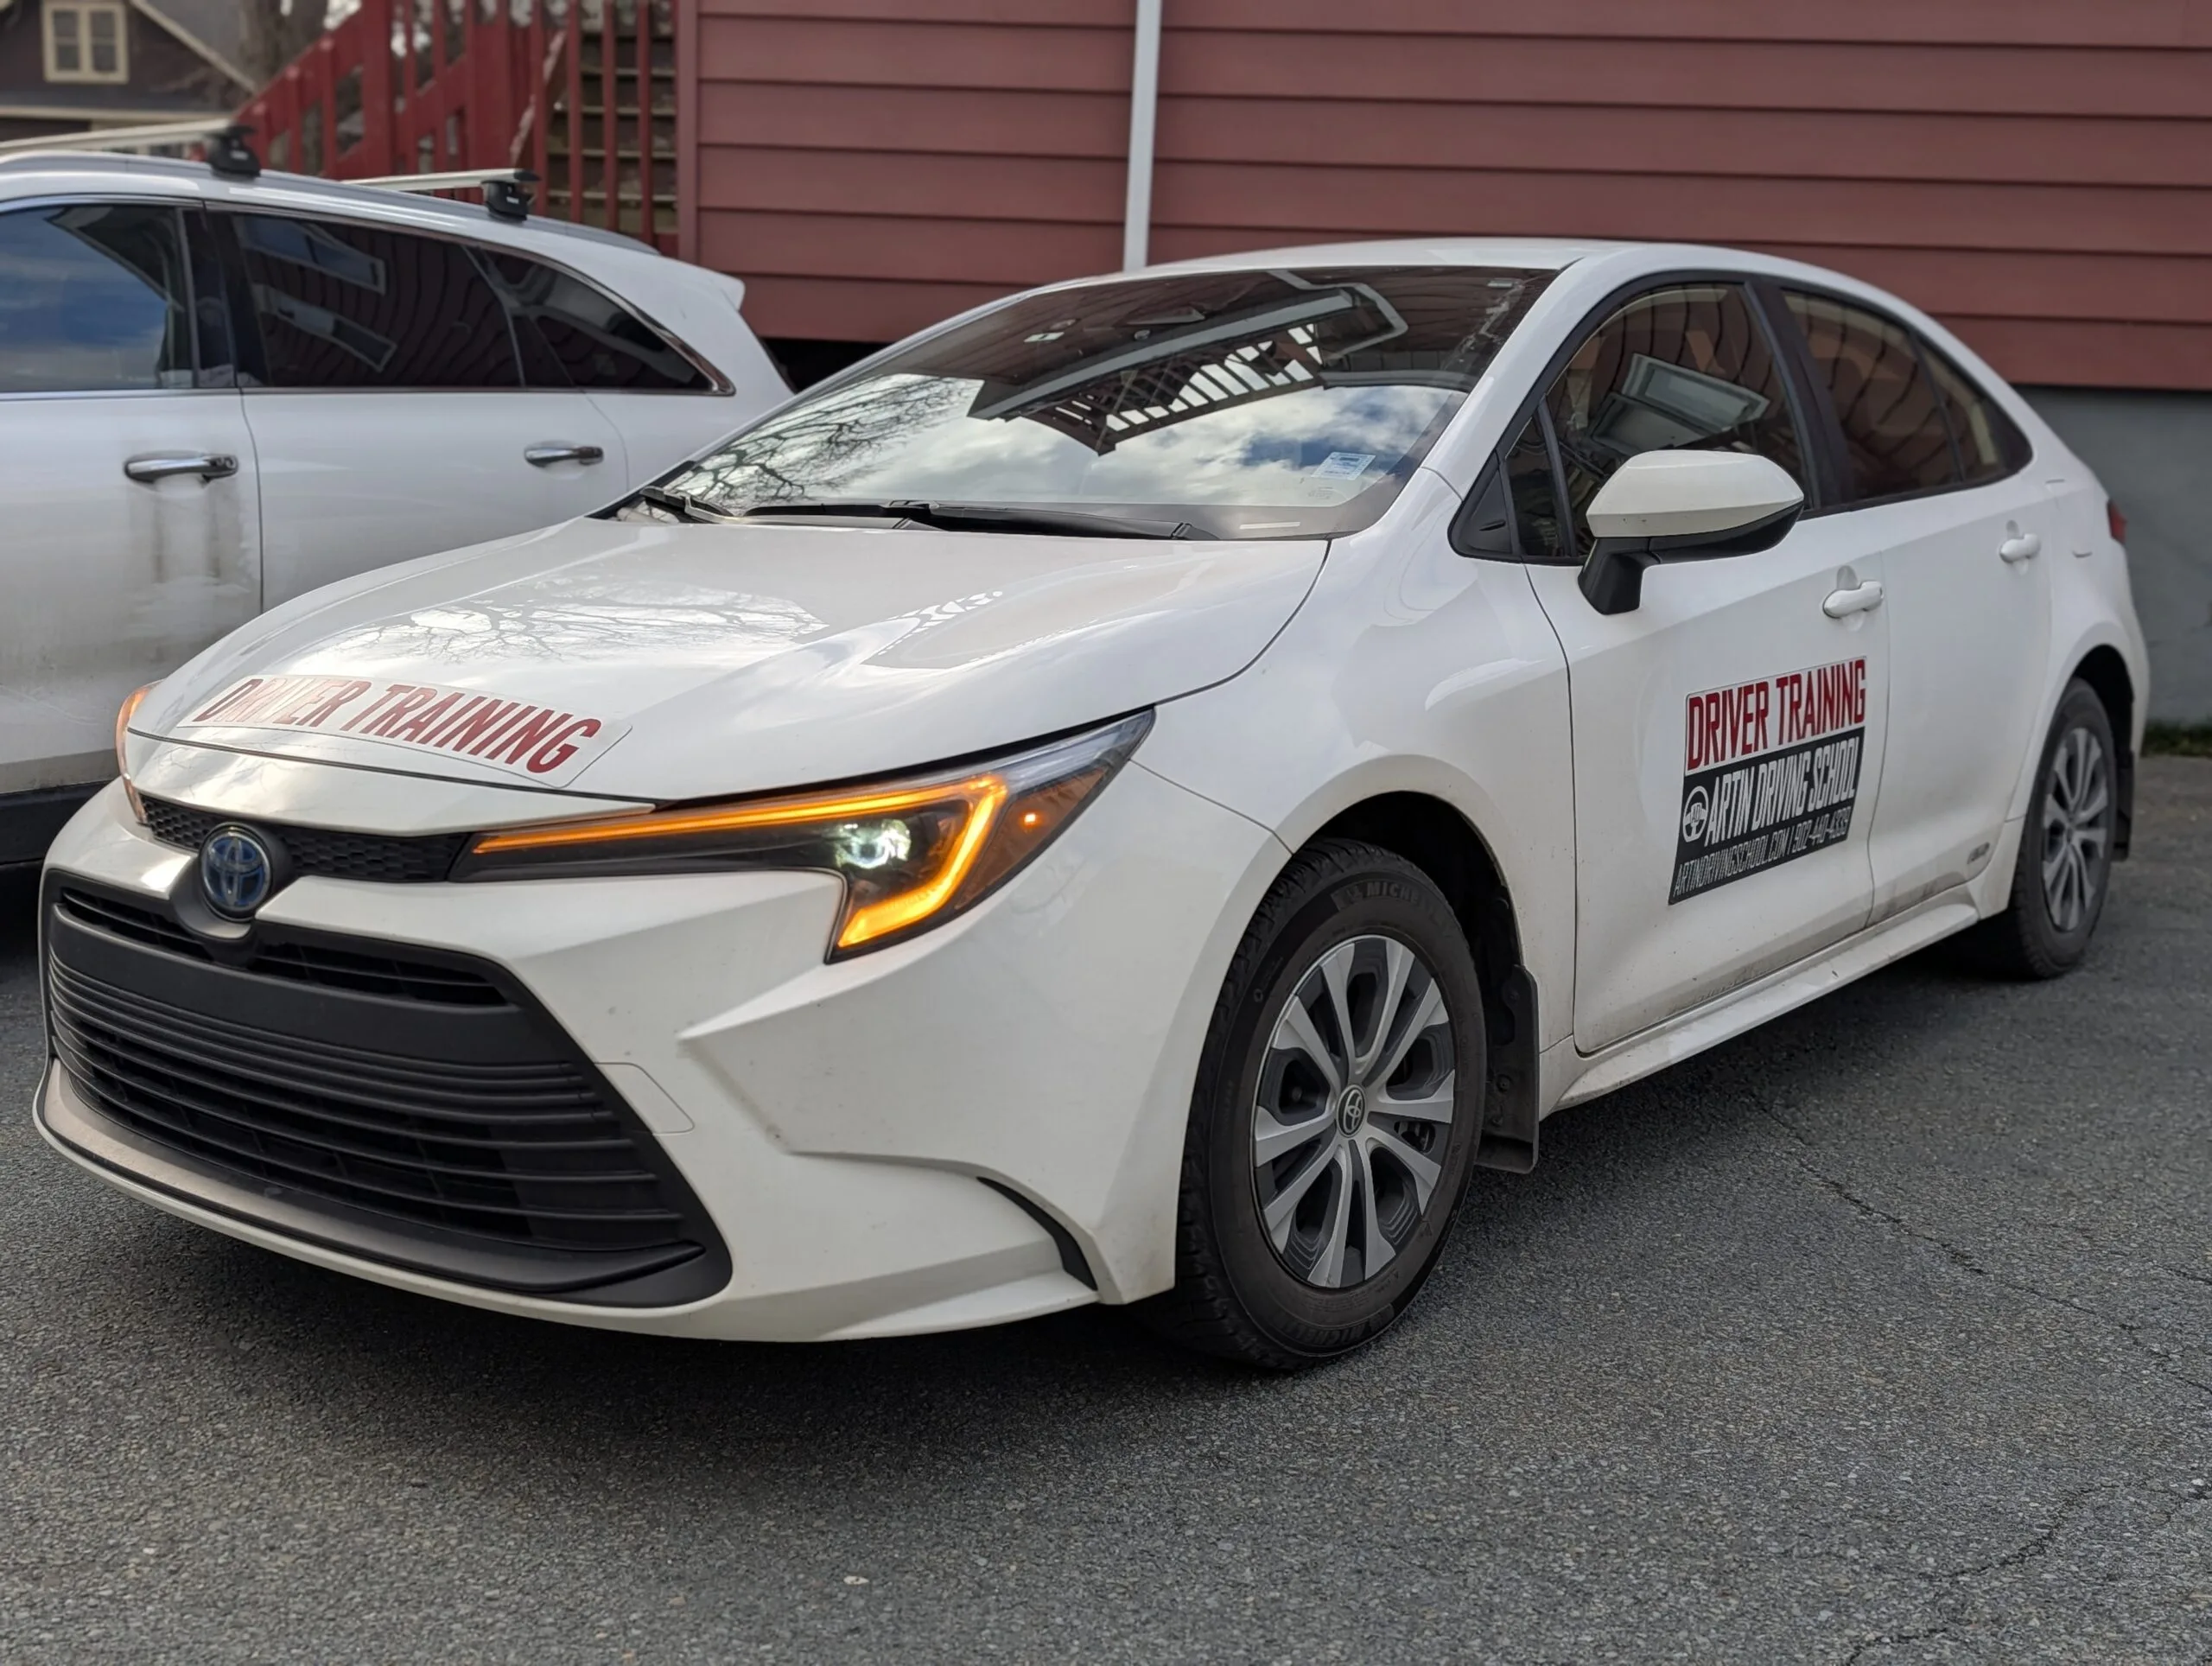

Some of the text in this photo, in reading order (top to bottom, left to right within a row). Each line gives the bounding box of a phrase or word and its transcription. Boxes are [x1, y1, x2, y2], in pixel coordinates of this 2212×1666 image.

[192, 678, 601, 773] DRIVER TRAINING
[1687, 658, 1866, 771] DRIVER TRAINING
[1704, 736, 1859, 847] ARTIN DRIVING SCHOOL
[1673, 827, 1790, 898] ARTINDRIVINGSCHOOL.COM
